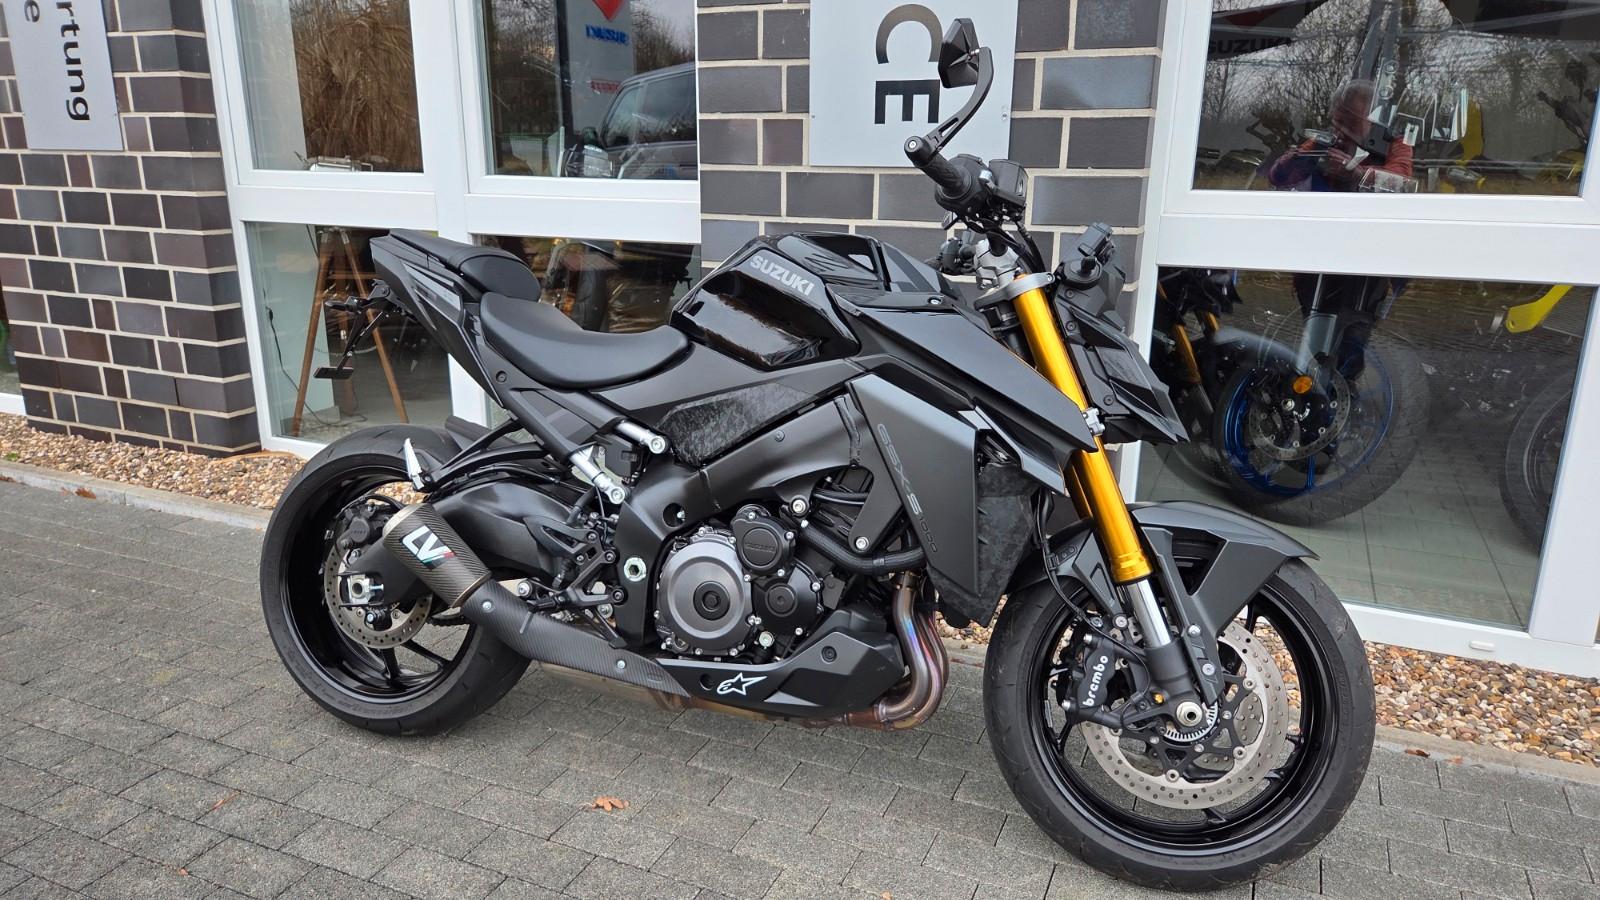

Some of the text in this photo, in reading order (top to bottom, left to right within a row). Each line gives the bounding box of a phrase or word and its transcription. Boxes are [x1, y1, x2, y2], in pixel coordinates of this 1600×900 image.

[24, 0, 40, 22] e
[56, 1, 90, 120] rtung
[874, 4, 943, 124] CE
[750, 255, 815, 296] SUZUKI
[1082, 655, 1109, 707] brembo
